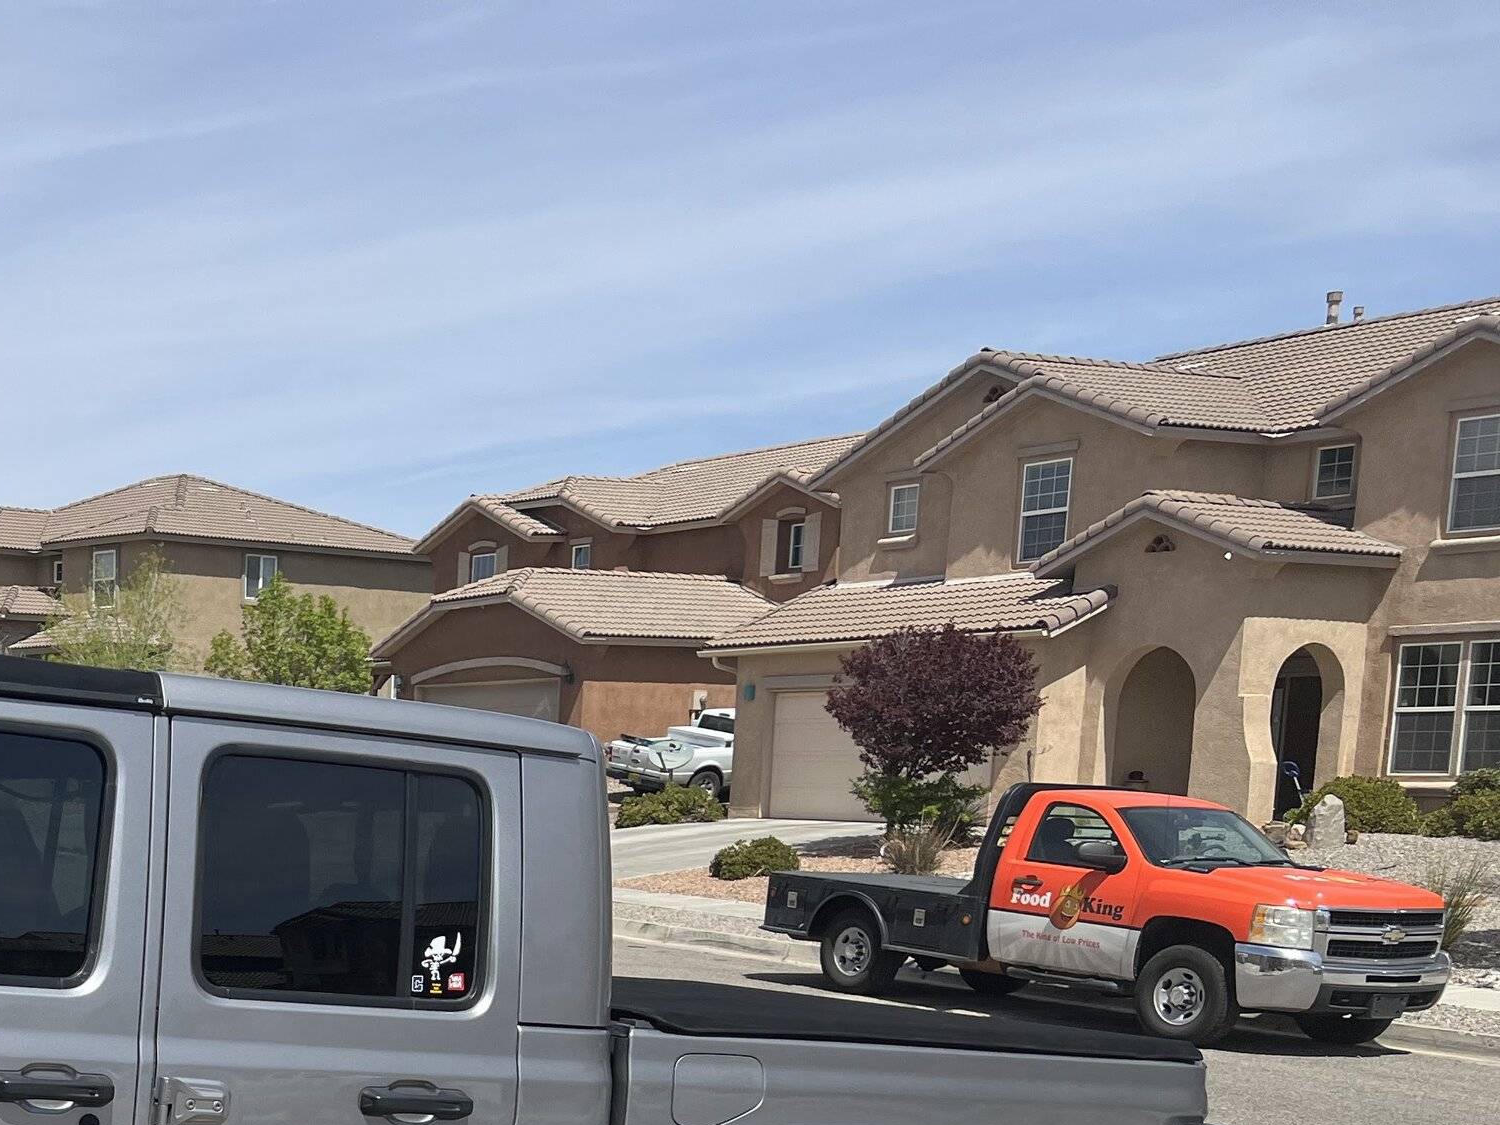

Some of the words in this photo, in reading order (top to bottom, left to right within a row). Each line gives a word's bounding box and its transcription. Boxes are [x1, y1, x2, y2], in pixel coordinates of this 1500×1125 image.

[1010, 888, 1052, 908] Food
[1081, 897, 1125, 920] King
[1021, 929, 1035, 939] The
[1052, 934, 1060, 942] of
[1062, 935, 1077, 945] Low
[1077, 938, 1101, 949] Prices
